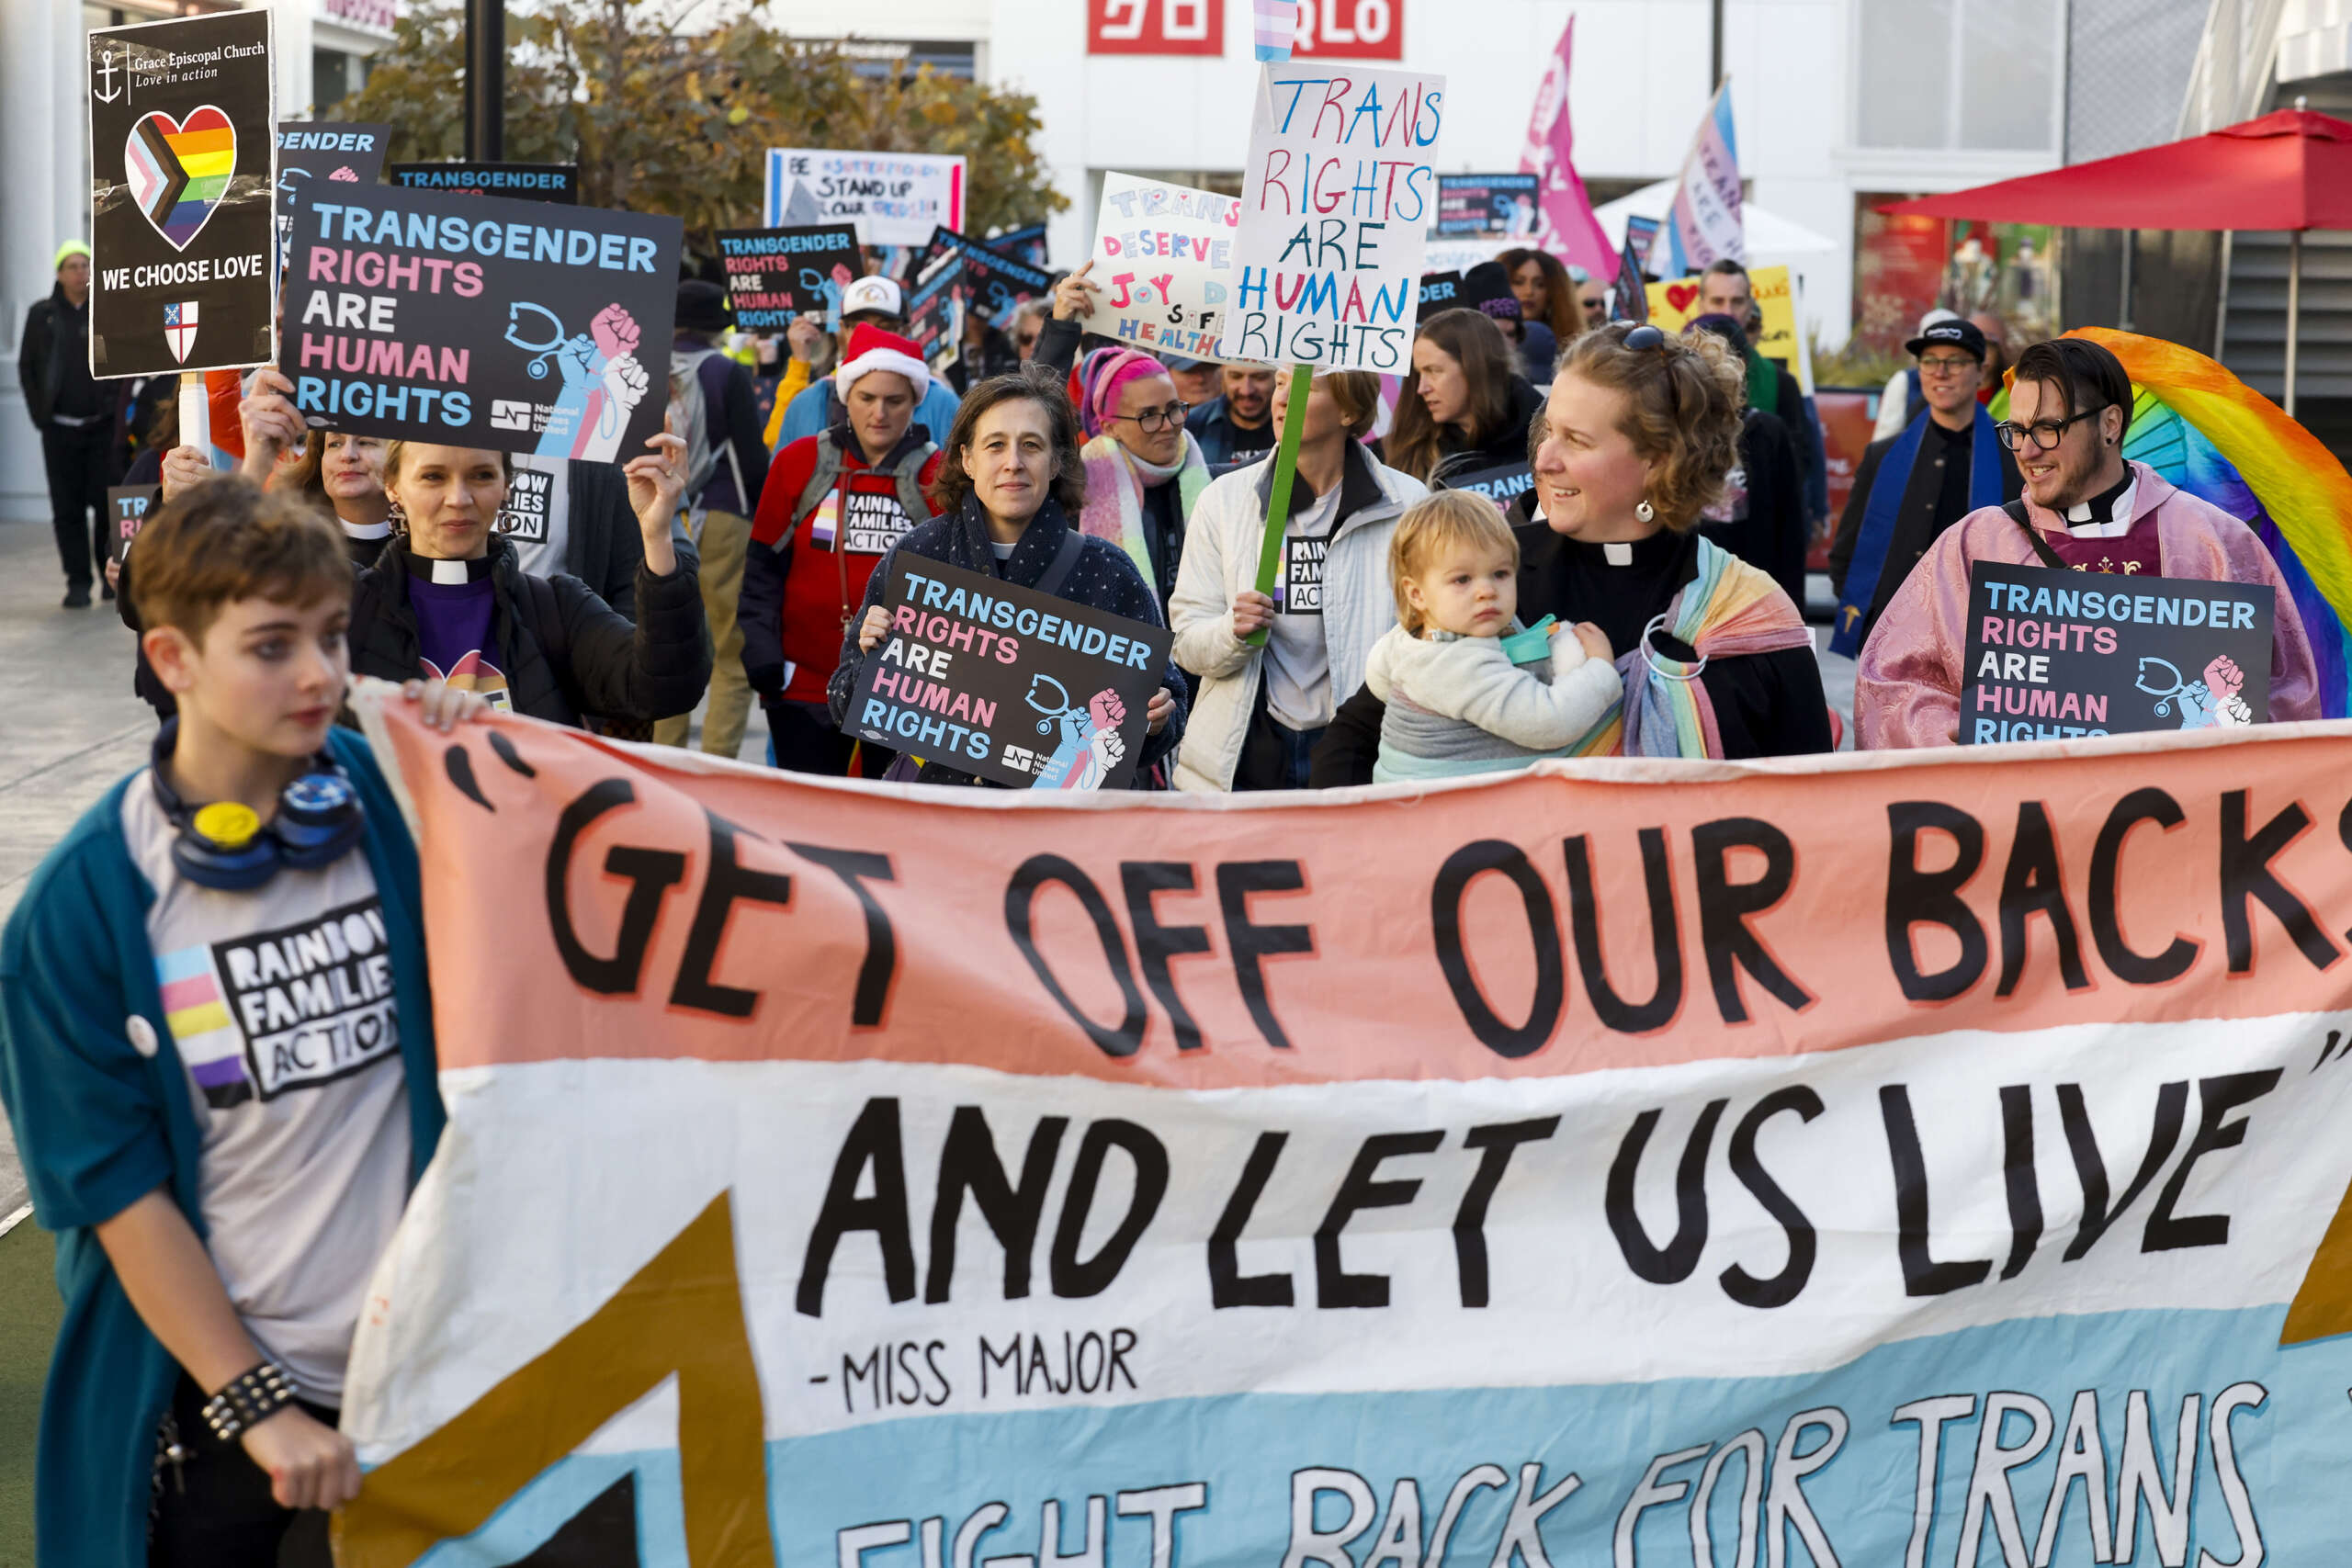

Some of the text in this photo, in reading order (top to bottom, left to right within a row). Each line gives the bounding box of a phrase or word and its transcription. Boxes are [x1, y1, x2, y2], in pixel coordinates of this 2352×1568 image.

[135, 41, 266, 71] Grace Episcopal Church
[135, 67, 218, 87] Love in action
[1273, 77, 1442, 148] TRANS
[399, 172, 567, 189] TRANSGENDER
[789, 157, 809, 175] BE
[1261, 149, 1432, 222] RIGHTS
[817, 177, 912, 197] STAND UP
[1109, 188, 1241, 227] TRANS
[312, 203, 658, 273] TRANSGENDER
[720, 232, 851, 256] TRANSGENDER
[1102, 230, 1230, 269] DESERVE
[1278, 219, 1385, 271] ARE
[102, 254, 263, 291] WE CHOOSE LOVE
[308, 246, 484, 298] RIGHTS
[724, 255, 789, 274] RIGHTS
[729, 275, 763, 291] ARE
[732, 292, 794, 309] HUMAN
[1109, 272, 1174, 309] JOY
[1238, 265, 1408, 324] HUMAN
[302, 289, 398, 333] ARE
[300, 333, 469, 384] HUMAN
[1238, 312, 1406, 368] RIGHTS
[297, 376, 472, 427] RIGHTS
[535, 403, 579, 417] National
[533, 423, 569, 435] United
[508, 491, 544, 513] IES
[509, 474, 548, 493] OW
[847, 495, 906, 515] RAINBO
[849, 513, 913, 532] AMILIES
[903, 572, 1151, 671] TRANSGENDER
[1984, 581, 2256, 629] TRANSGENDER
[893, 604, 1020, 665] RIGHTS
[1981, 615, 2118, 654] RIGHTS
[881, 640, 954, 680] ARE
[1977, 650, 2050, 683] ARE
[871, 667, 999, 728] HUMAN
[1976, 684, 2108, 723] HUMAN
[861, 698, 991, 761] RIGHTS
[1035, 752, 1069, 769] National
[1003, 852, 1314, 1057] OFF
[1431, 817, 1813, 1058] OUR
[1885, 787, 2352, 1001] BACK
[239, 953, 395, 1034] FAMILIE
[796, 1097, 1170, 1319] AND
[1207, 1114, 1562, 1311] LET
[1605, 1084, 1826, 1309] US
[979, 1327, 1139, 1400] MAJOR
[1613, 1406, 1849, 1568] FOR
[1892, 1382, 2269, 1568] TRANS
